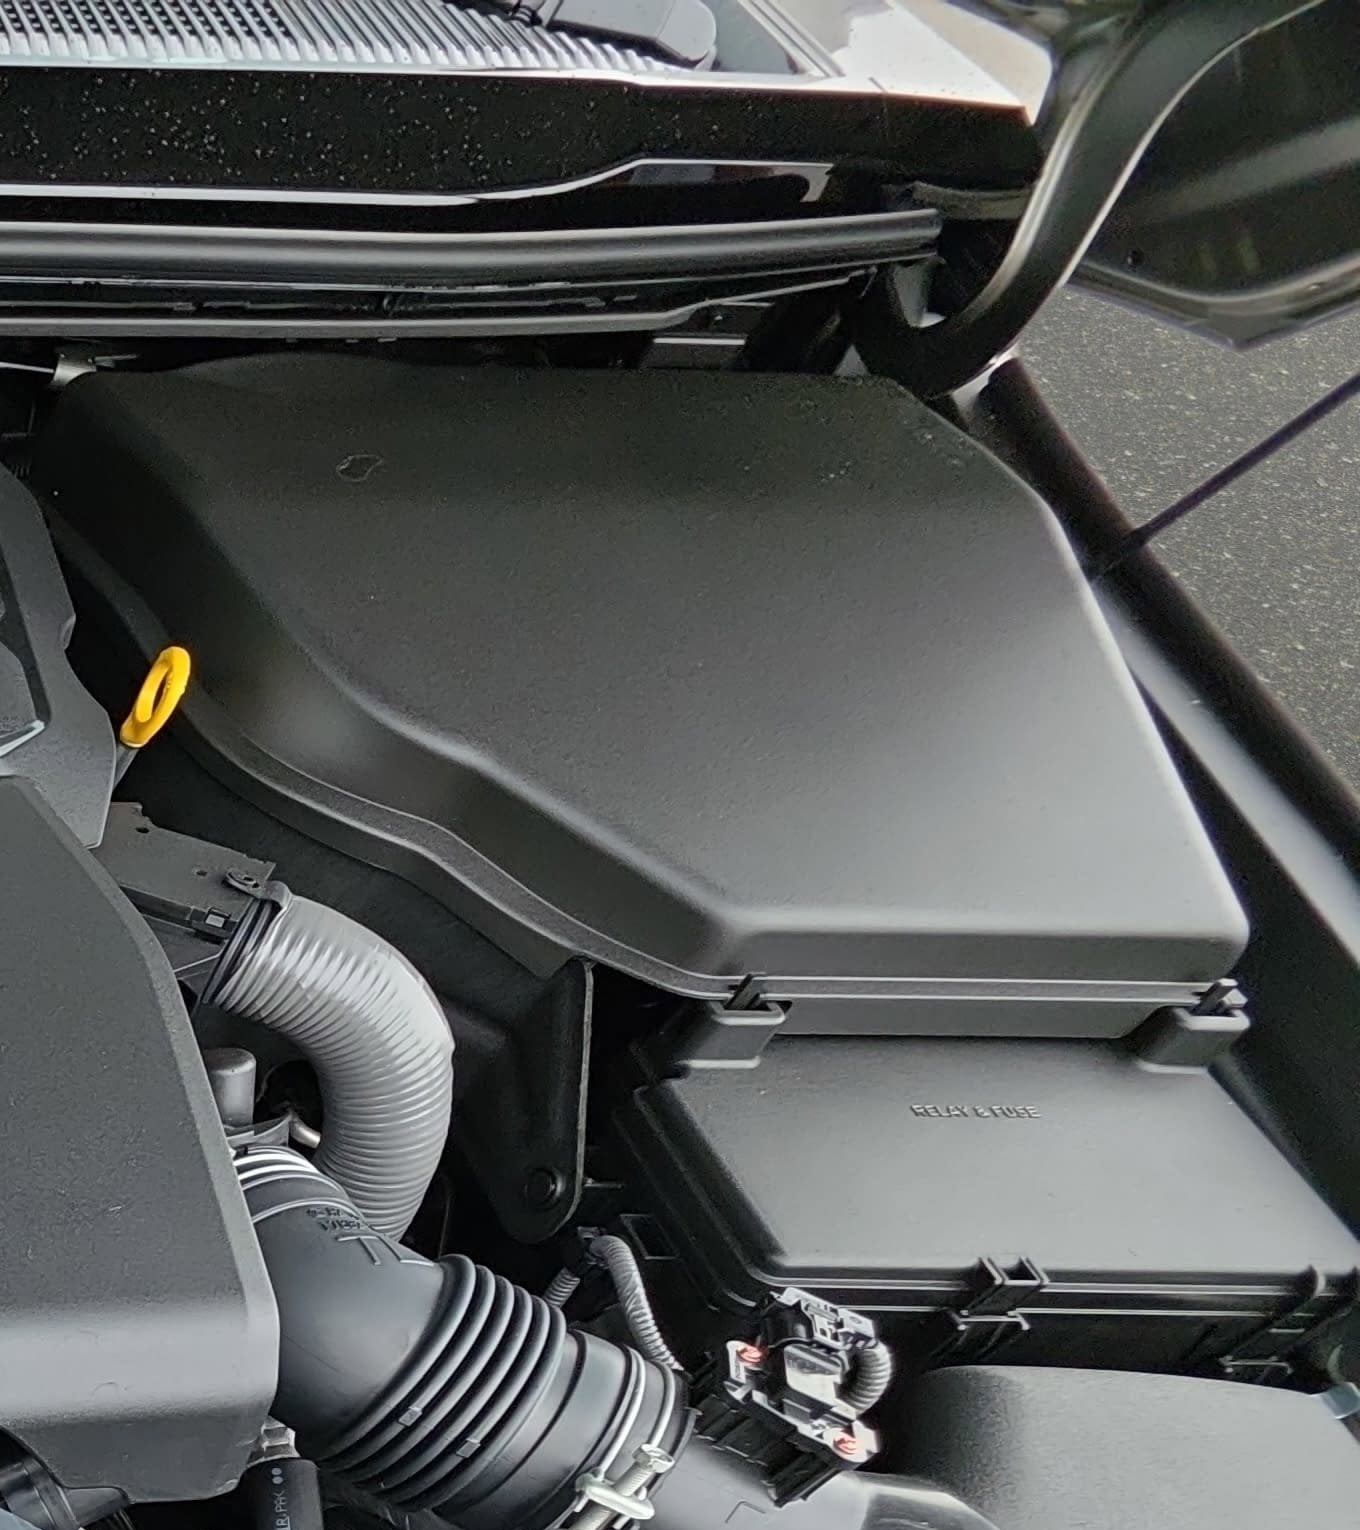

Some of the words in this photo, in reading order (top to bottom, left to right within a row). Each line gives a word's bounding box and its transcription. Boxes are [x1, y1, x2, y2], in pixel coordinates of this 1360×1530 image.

[910, 1104, 969, 1118] RELAY
[973, 1105, 989, 1118] &
[989, 1105, 1043, 1118] FUSE
